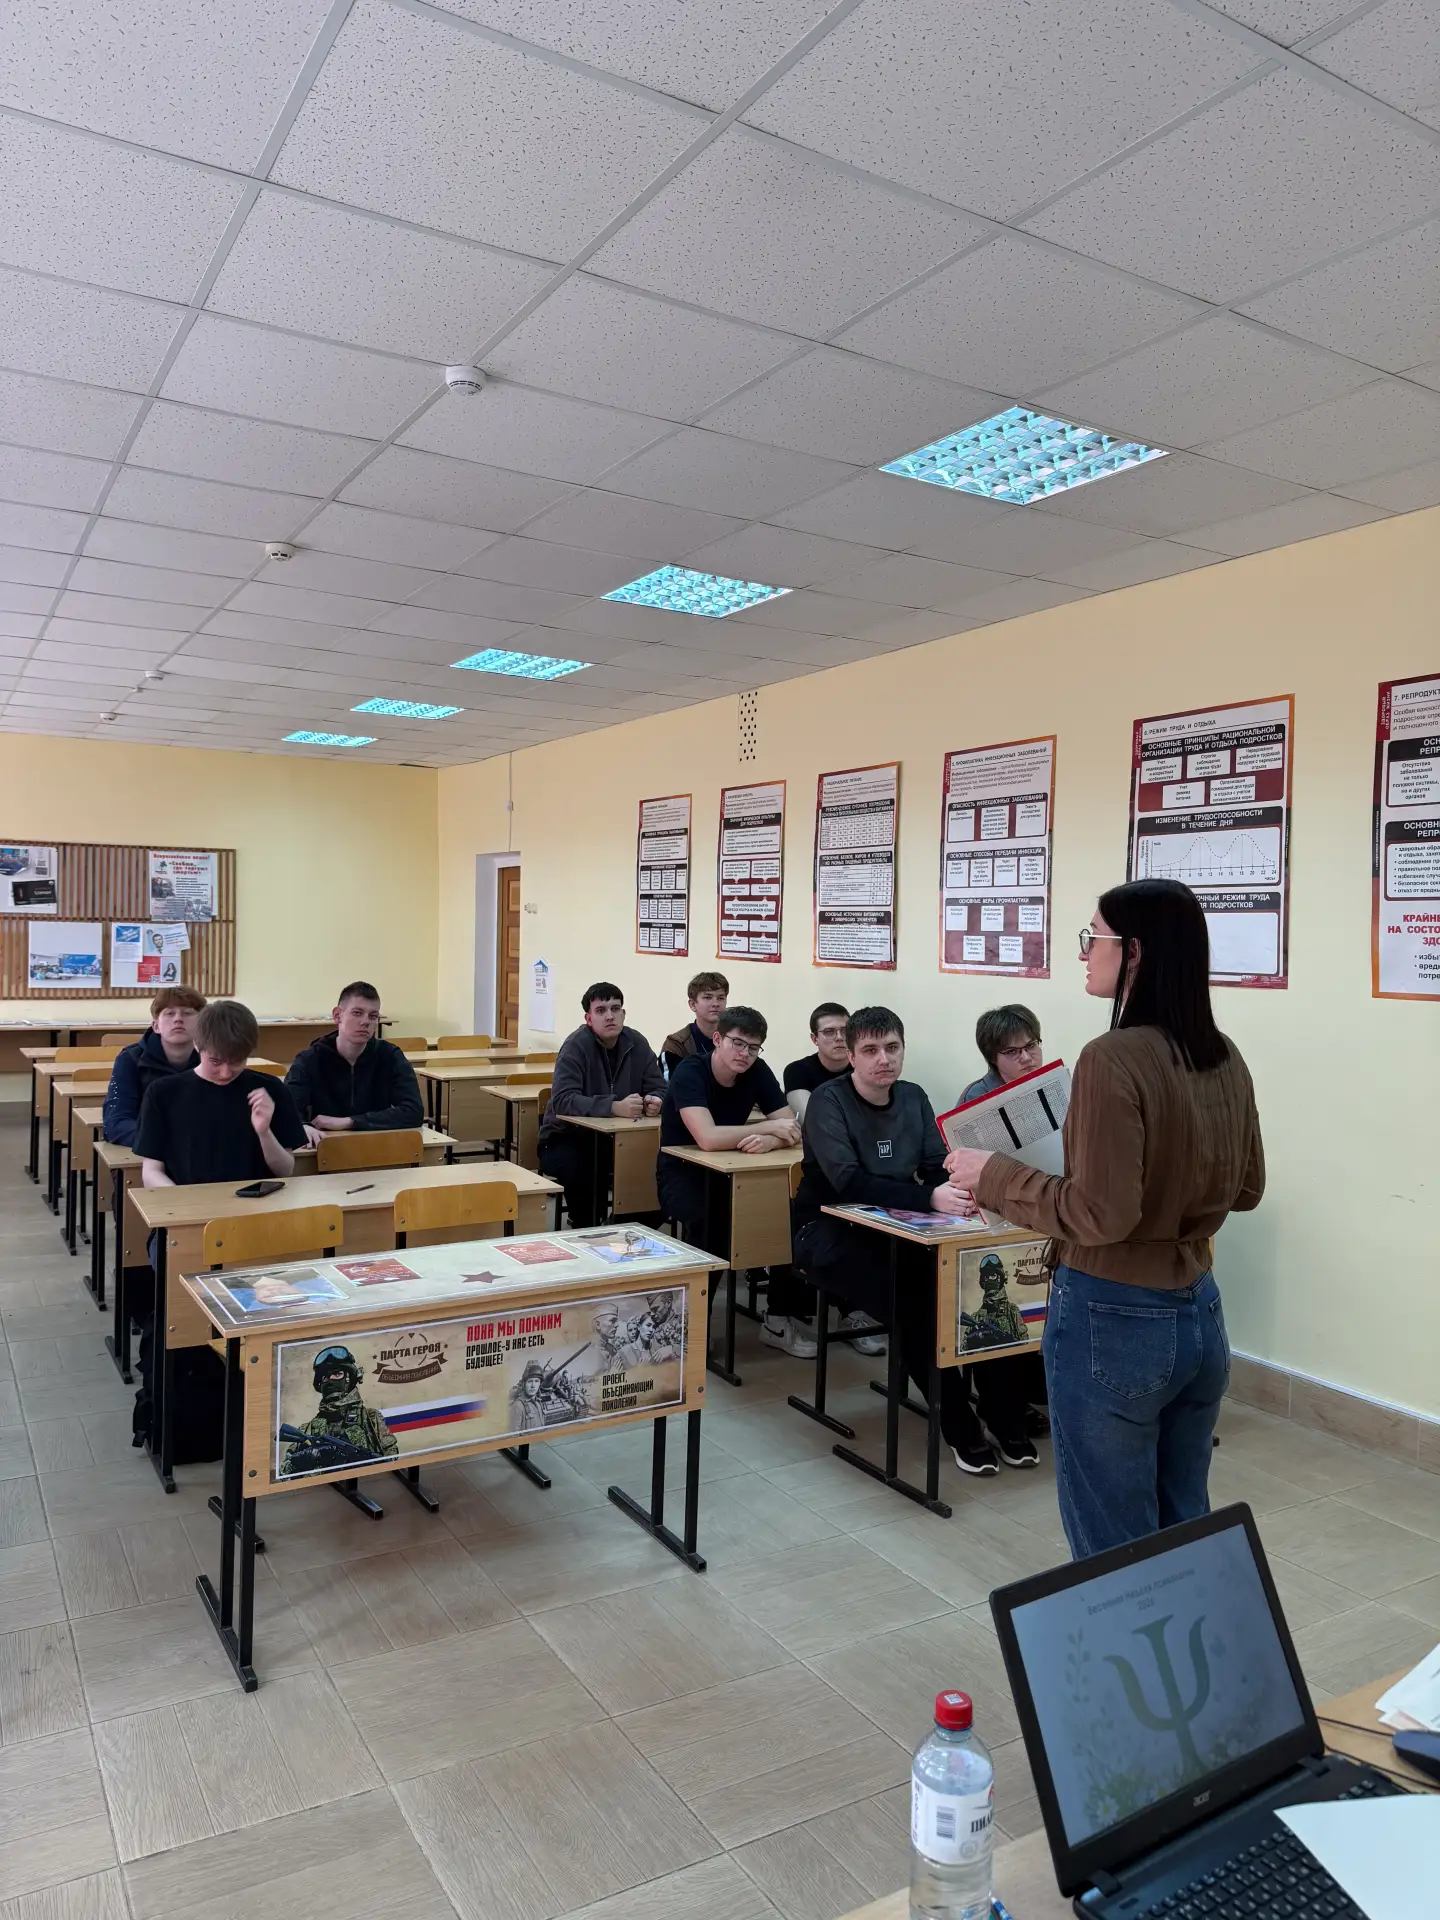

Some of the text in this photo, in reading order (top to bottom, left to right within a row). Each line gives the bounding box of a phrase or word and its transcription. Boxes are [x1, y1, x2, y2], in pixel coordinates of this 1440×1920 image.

[1394, 715, 1425, 723] подростков
[1399, 721, 1438, 730] полноценного
[1149, 727, 1167, 735] РЕЖИМ
[1169, 724, 1185, 732] ТРУДА
[1194, 719, 1216, 728] ОТДЫХА
[1148, 726, 1276, 750] ОСНОВНЫЕ ПРИНЦИПЫ РАЦИОНАЛЬНОЙ
[1142, 747, 1183, 758] ОРГАНИЗАЦИИ
[1185, 744, 1203, 752] ТРУДА
[1211, 740, 1237, 748] ОТДЫХА
[1240, 733, 1283, 745] ПОДРОСТКОВ
[985, 753, 1016, 761] ИНФЕКЦИОННЫХ
[1017, 747, 1047, 757] ЗАБОЛЕВАНИЙ
[976, 797, 1010, 806] ИНФЕКЦИОННЫХ
[1011, 793, 1044, 802] ЗАБОЛЕВАНИЙ
[1156, 809, 1263, 824] ИЗМЕНЕНИЕ ТРУДОСПОСОБНОСТИ
[1189, 821, 1217, 829] ТЕЧЕНИЕ
[1219, 819, 1233, 827] ДНЯ
[1417, 829, 1440, 837] РЕПР
[1249, 893, 1270, 901] ТРУДА
[1403, 912, 1440, 923] КРАЙНЕ
[1388, 925, 1440, 934] НА СОСТО
[880, 1144, 889, 1153] GAP
[1017, 1258, 1035, 1267] ПАРТА
[467, 1313, 562, 1342] ПОКА МЫ ПОМНИМ
[512, 1336, 527, 1350] НАС
[528, 1334, 545, 1348] ЕСТЬ
[380, 1342, 441, 1361] ПАРТА ГЕРОЯ
[466, 1353, 503, 1370] БУДУЩЕЕ!
[602, 1372, 628, 1386] ПРОЕКТ,
[602, 1377, 653, 1399] ОБЪЕДИНЯЮЩИЙ
[602, 1395, 637, 1411] ПОКОЛЕНИЯ
